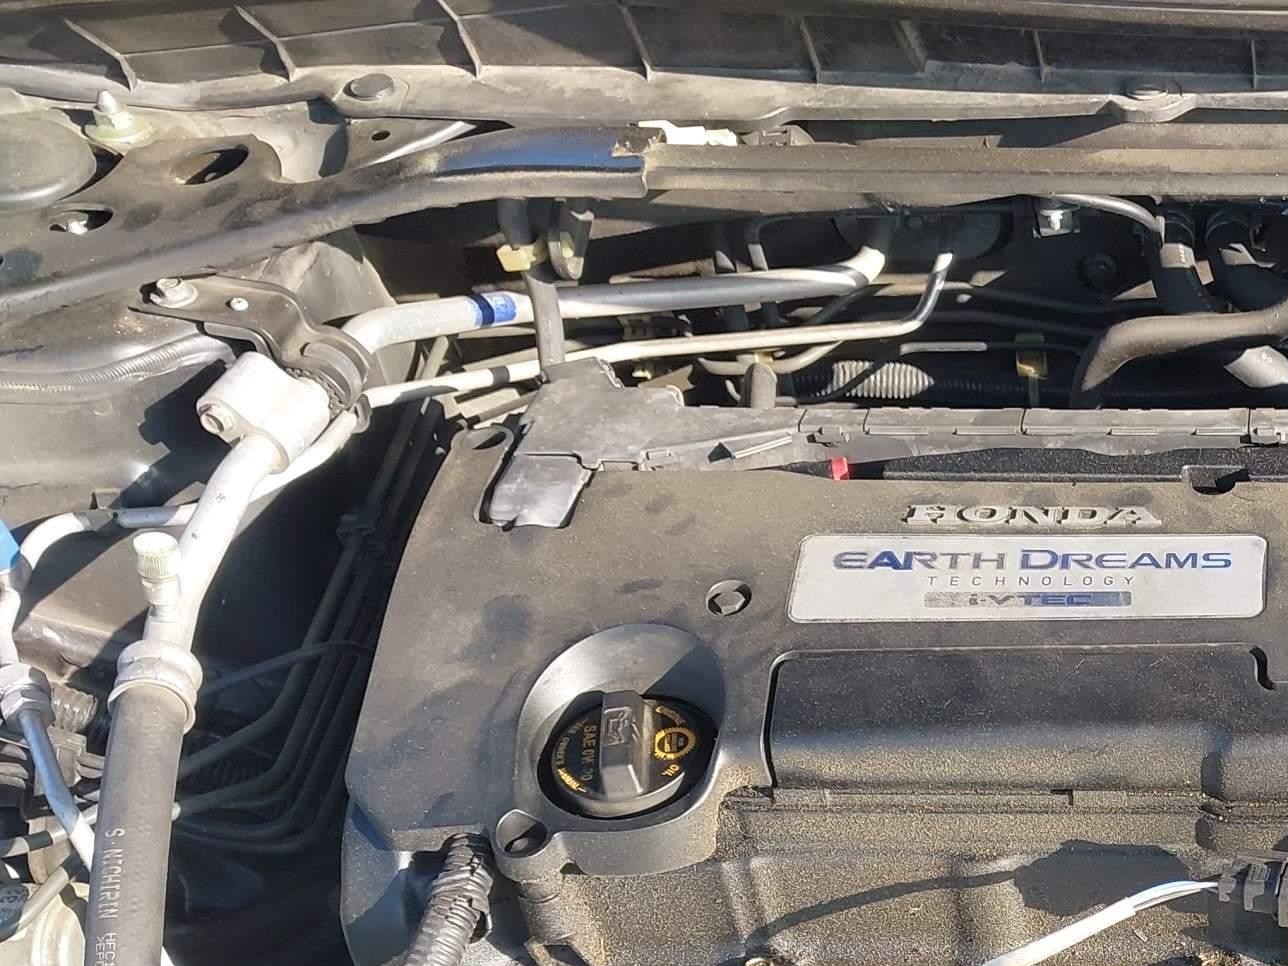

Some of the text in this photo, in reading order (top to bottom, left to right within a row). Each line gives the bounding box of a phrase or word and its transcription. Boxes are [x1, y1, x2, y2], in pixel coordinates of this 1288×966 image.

[903, 504, 1162, 526] HONDA
[833, 549, 1232, 571] EARTH DREAMS
[927, 575, 1136, 587] TECHNOLOGY
[583, 726, 597, 747] SAE
